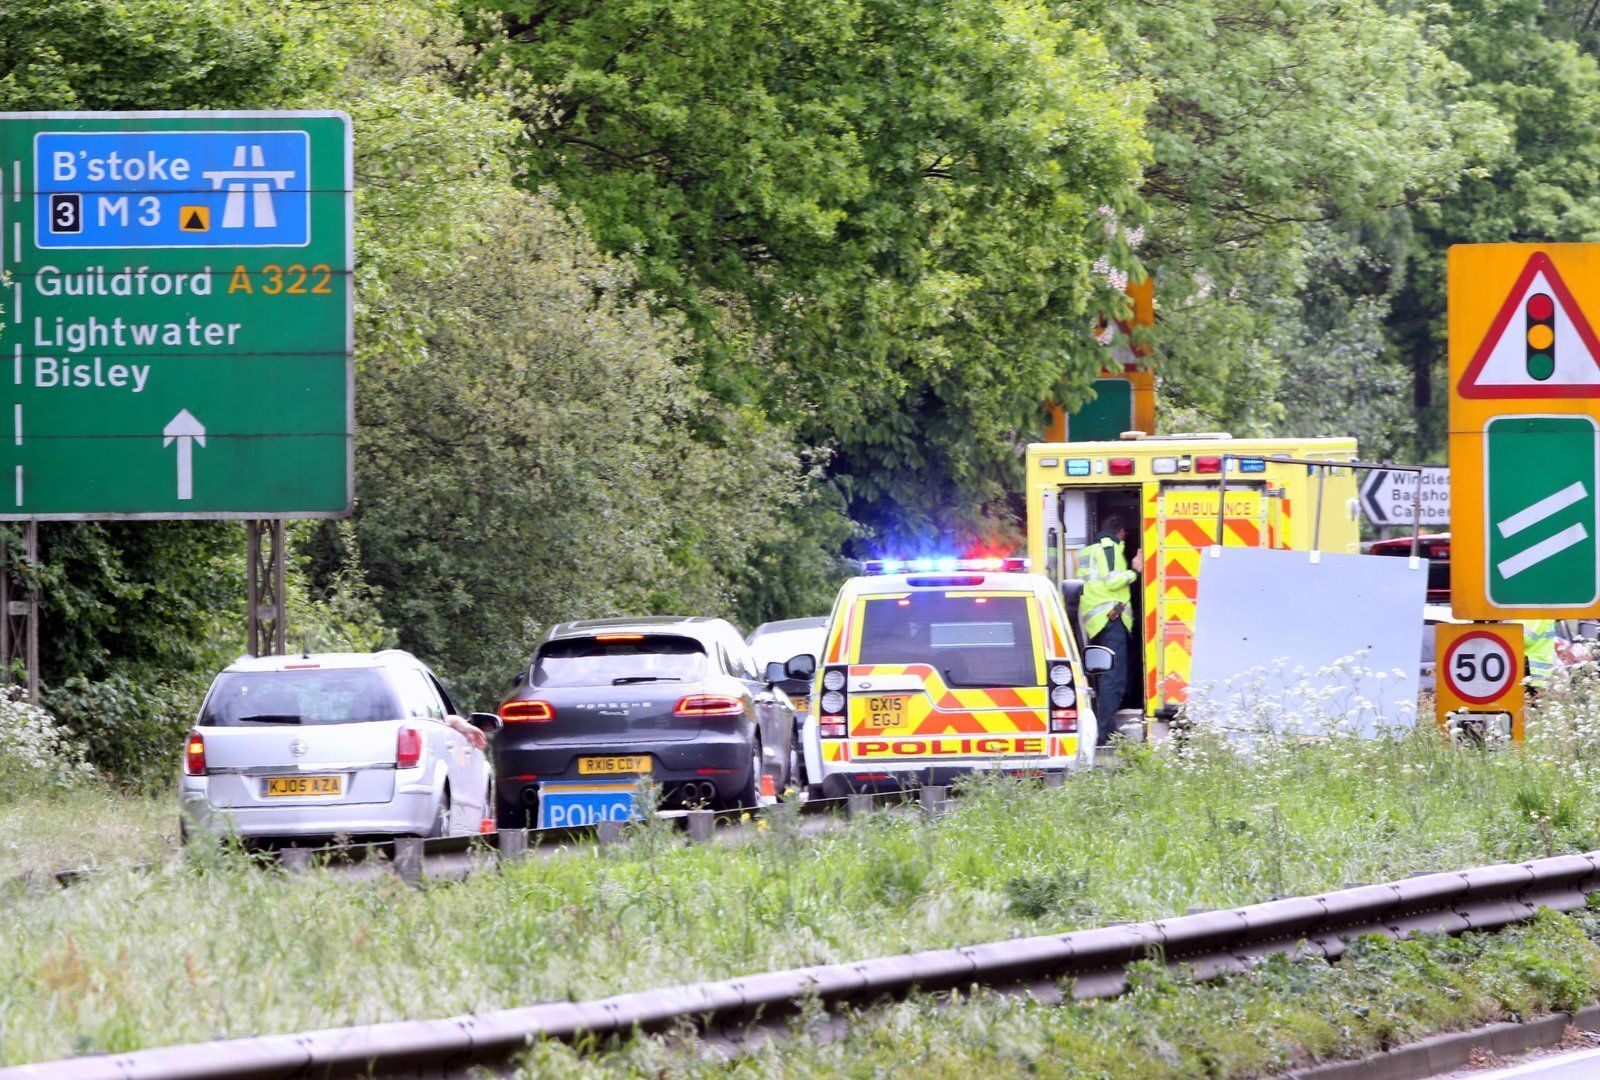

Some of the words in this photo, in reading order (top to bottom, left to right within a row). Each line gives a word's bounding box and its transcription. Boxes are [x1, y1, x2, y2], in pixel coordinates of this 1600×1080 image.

[53, 150, 191, 182] B'stoke
[56, 201, 75, 227] 3
[35, 264, 212, 296] Guildford
[34, 316, 242, 353] Lightwater
[34, 357, 151, 393] Bisley
[1173, 502, 1251, 516] AMBULNCE
[1456, 652, 1505, 682] 50
[870, 698, 902, 711] GX15
[872, 713, 900, 727] EGJ
[857, 738, 1043, 756] POLICE
[586, 759, 614, 771] RX16
[269, 779, 307, 793] KJ05
[311, 778, 339, 792] AZA
[549, 803, 636, 828] POLIC
